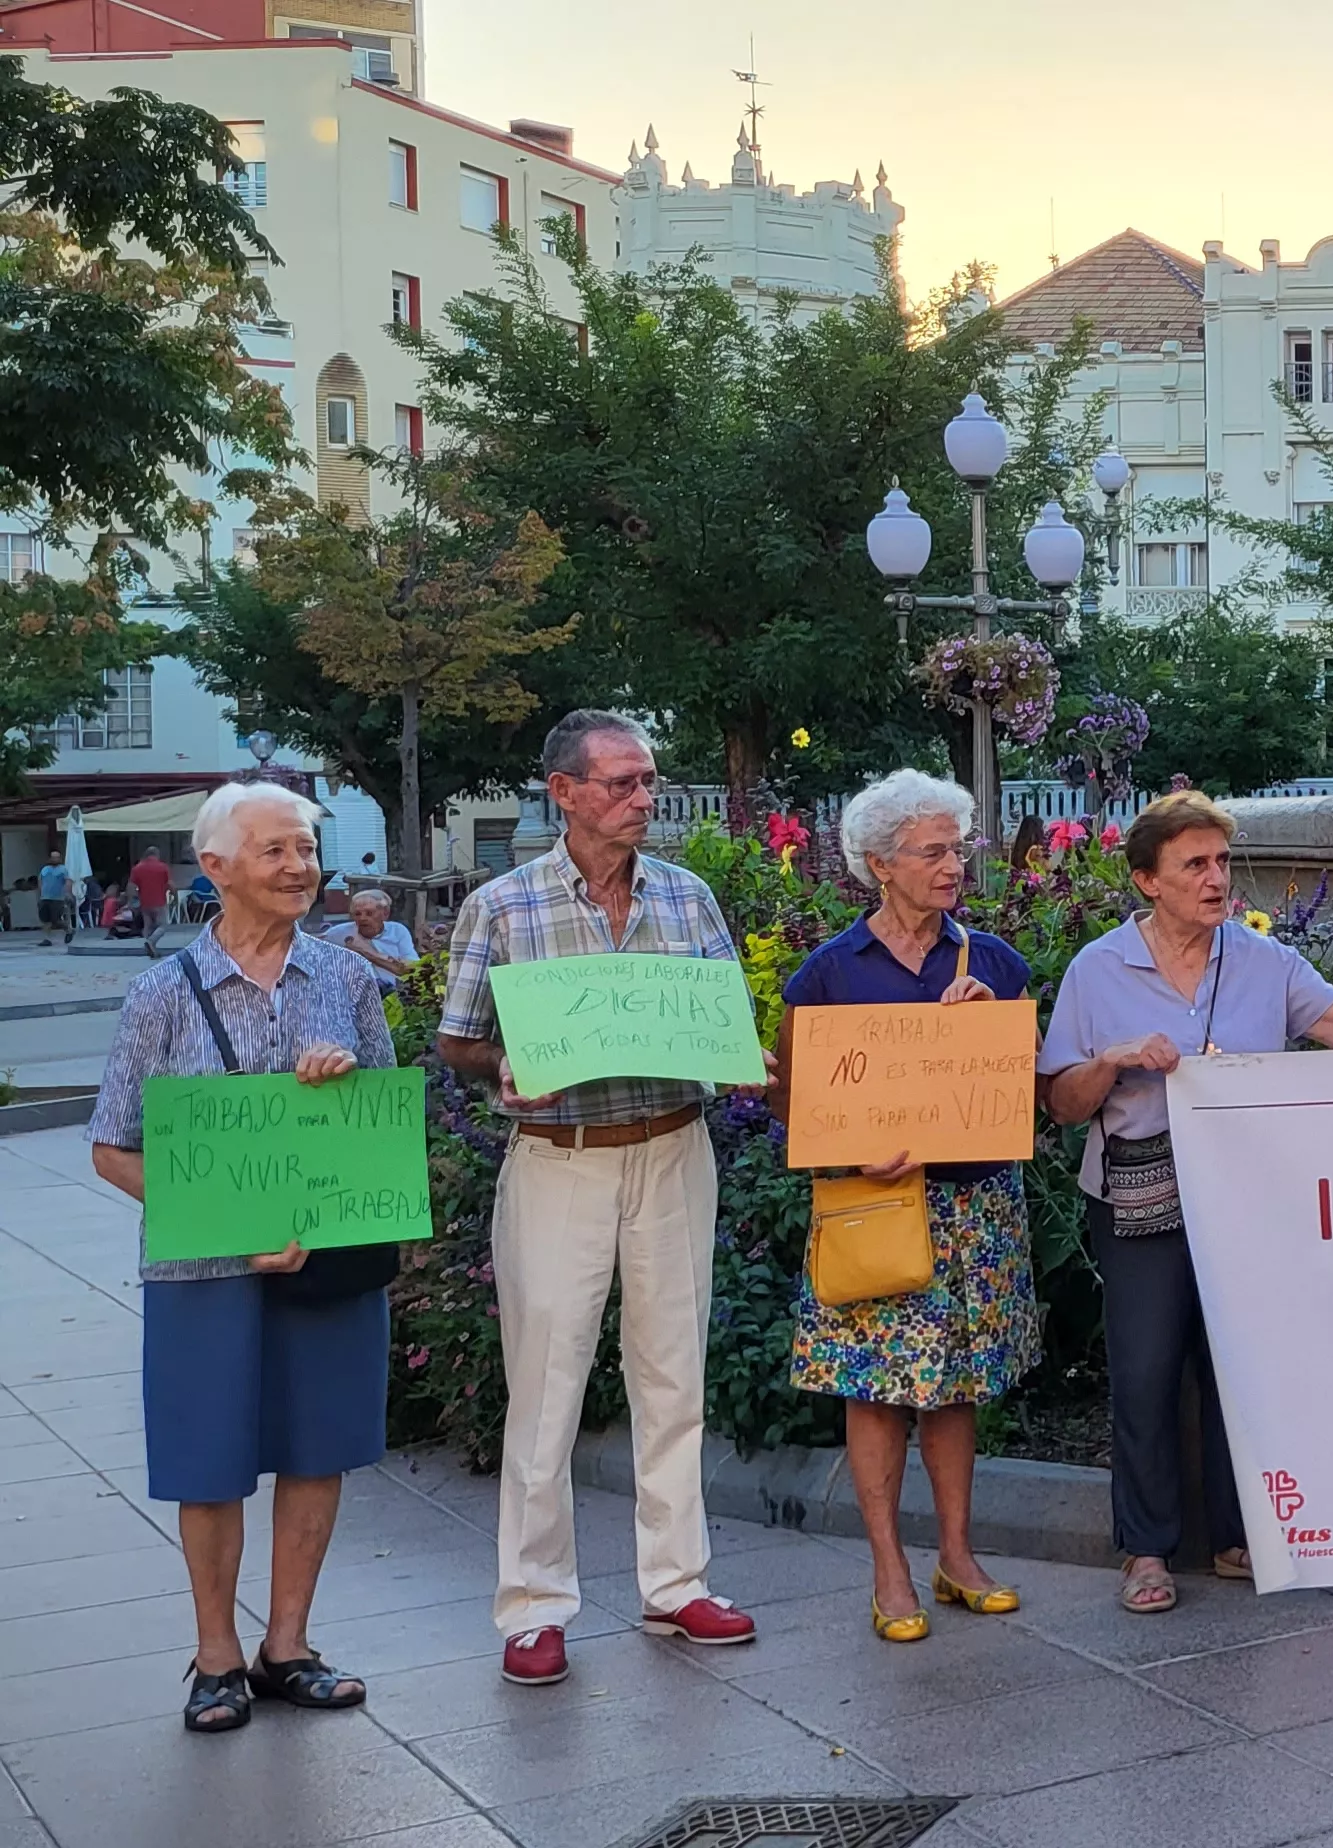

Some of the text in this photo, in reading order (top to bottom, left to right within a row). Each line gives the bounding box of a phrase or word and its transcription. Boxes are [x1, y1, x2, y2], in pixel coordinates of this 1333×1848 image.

[514, 961, 733, 987] CONDICIONES LABORALES
[564, 984, 732, 1028] DIGNAS
[521, 1037, 575, 1064] PARA
[583, 1026, 651, 1049] TODAS
[675, 1030, 742, 1055] TODOS
[808, 1014, 953, 1048] EL TRABAJO
[829, 1048, 867, 1087] NO
[886, 1062, 907, 1079] ES
[919, 1058, 954, 1077] PARA
[155, 1077, 413, 1137] UN TRABAJO PARA VIVIR
[867, 1105, 907, 1130] PARA
[952, 1082, 1029, 1130] VIDA
[169, 1141, 339, 1192] NO VIVIR PARA
[292, 1206, 320, 1237] UN
